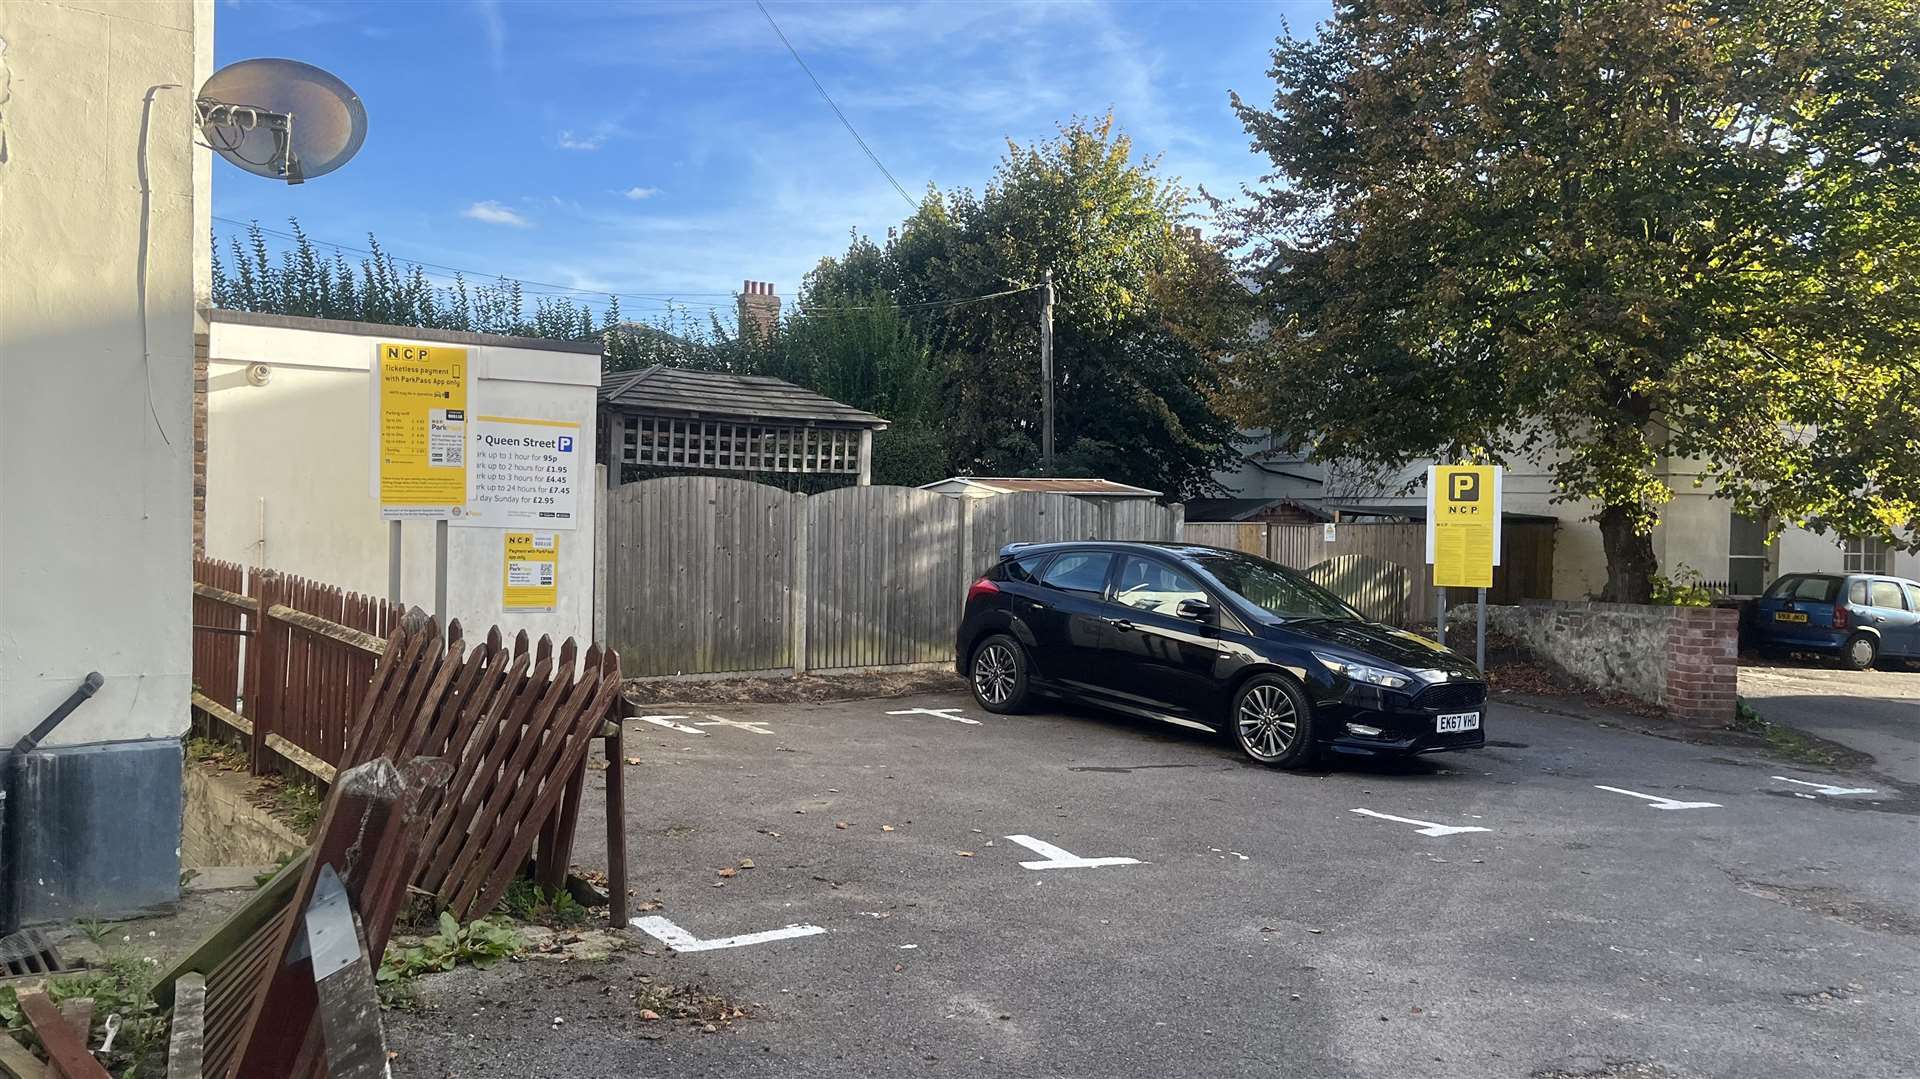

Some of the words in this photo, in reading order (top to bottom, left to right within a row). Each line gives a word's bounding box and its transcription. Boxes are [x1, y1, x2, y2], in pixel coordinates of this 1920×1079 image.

[385, 364, 418, 373] Ticketless
[420, 368, 448, 376] payment
[401, 376, 432, 384] ParkPass
[433, 378, 444, 386] App
[446, 379, 460, 388] only
[485, 434, 520, 446] Queen
[523, 438, 556, 448] Street
[488, 452, 497, 460] up
[514, 453, 530, 462] hour
[543, 454, 558, 463] 95p
[514, 464, 533, 472] hours
[546, 466, 568, 474] £1.95
[513, 474, 533, 482] hours
[546, 476, 566, 484] £4.45
[548, 486, 570, 494] £7.45
[480, 494, 492, 503] day
[494, 494, 520, 504] Sunday
[533, 496, 554, 504] £2.95
[1449, 506, 1478, 514] NCP
[1440, 716, 1461, 730] EK67
[1463, 714, 1476, 728] VHO
